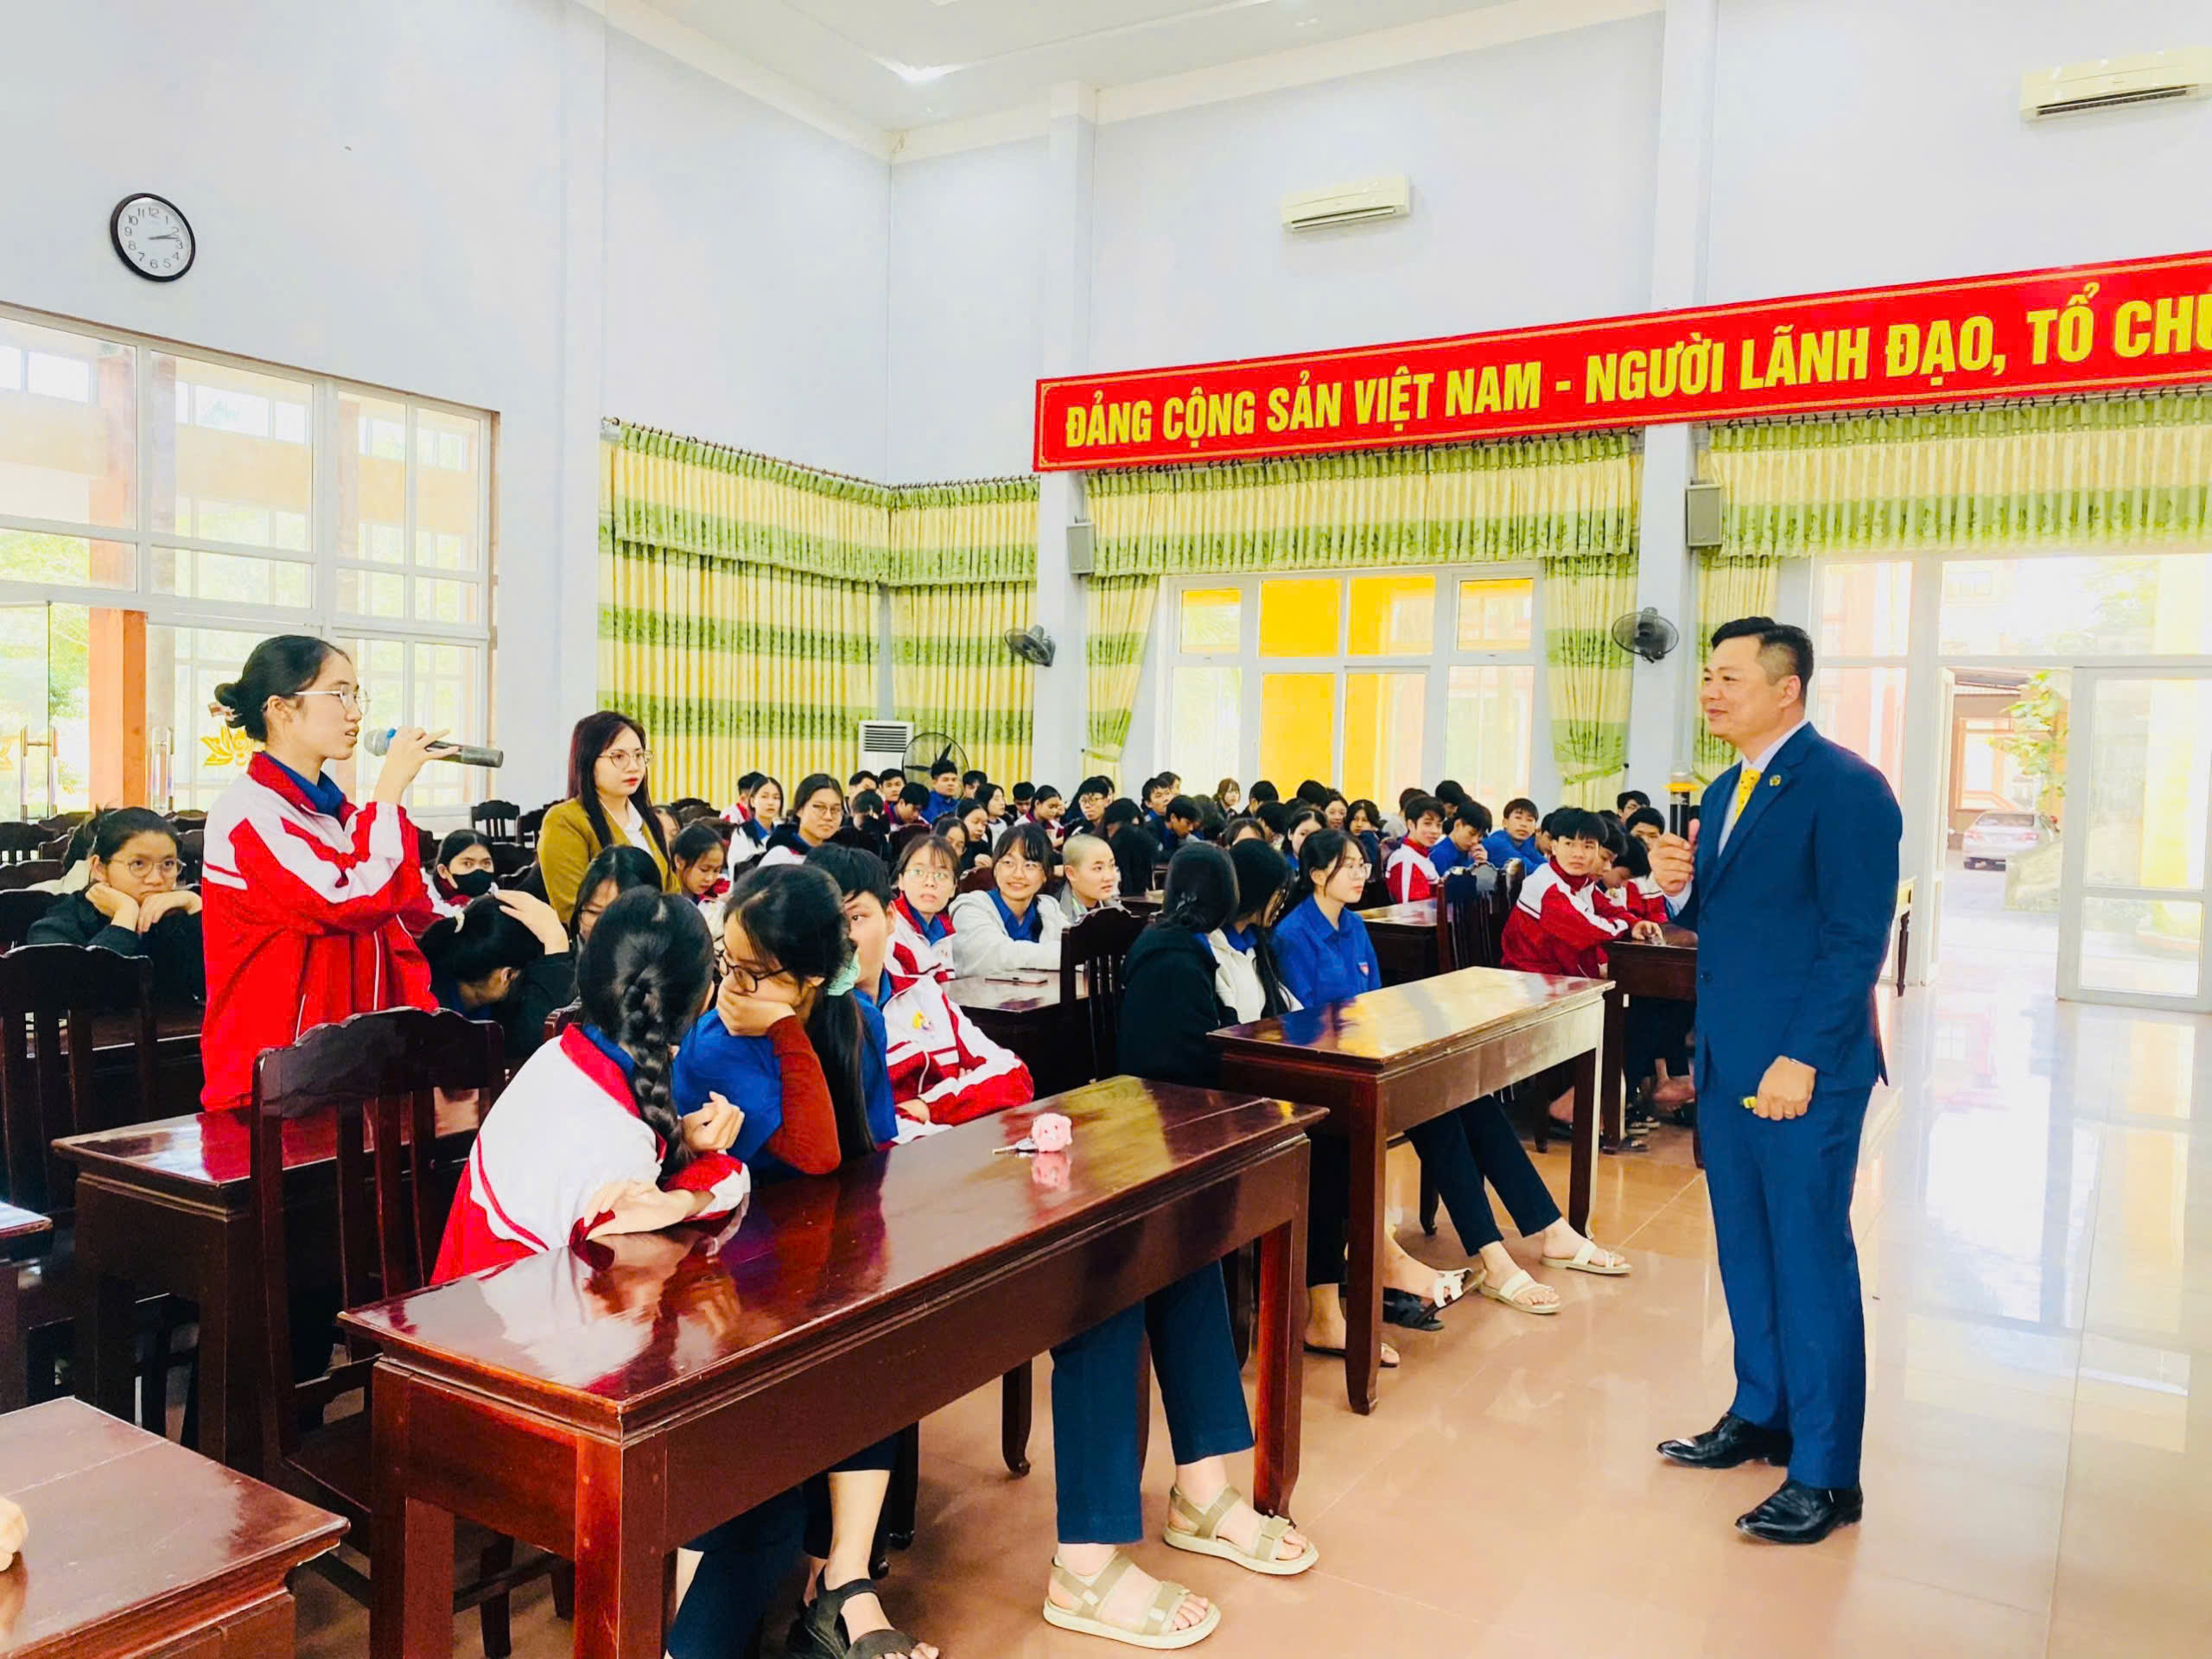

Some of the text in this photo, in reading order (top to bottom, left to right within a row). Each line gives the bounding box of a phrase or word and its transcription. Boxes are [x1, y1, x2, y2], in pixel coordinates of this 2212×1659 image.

[138, 207, 145, 219] 11
[128, 214, 138, 226] 10
[124, 226, 132, 237] 9
[128, 240, 137, 251] 8
[175, 239, 183, 250] 3
[138, 251, 145, 262] 7
[173, 251, 179, 261] 4
[149, 259, 159, 269] 6
[163, 258, 172, 269] 5
[1065, 390, 1153, 448] ĐẢNG
[1162, 387, 1255, 448] CỘNG
[1267, 371, 1342, 431] SẢN
[1354, 366, 1435, 432] VIỆT
[1445, 361, 1542, 416] NAM
[1586, 332, 1725, 404] NGƯỜI
[1739, 324, 1871, 390] LÃNH
[1885, 315, 2006, 386] ĐẠO,
[2026, 282, 2101, 365] TỔ
